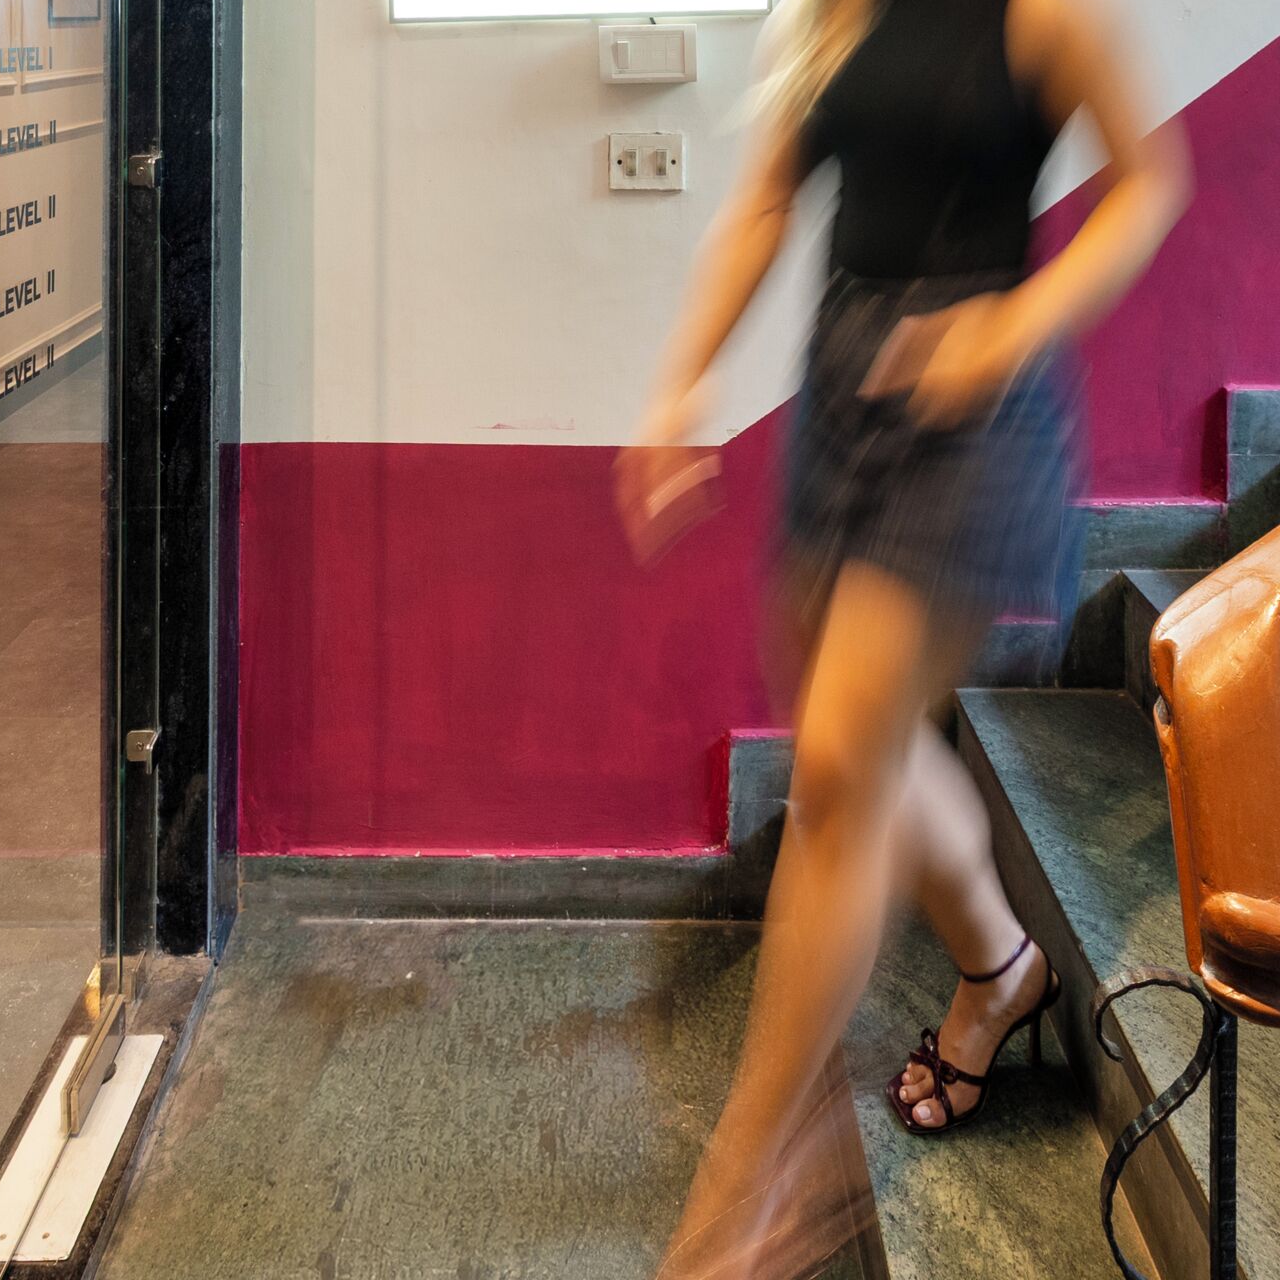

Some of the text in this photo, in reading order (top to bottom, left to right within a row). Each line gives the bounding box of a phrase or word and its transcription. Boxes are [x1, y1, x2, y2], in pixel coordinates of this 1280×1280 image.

[49, 120, 57, 144] II
[48, 194, 56, 219] II
[47, 269, 55, 295] II
[47, 344, 55, 370] II
